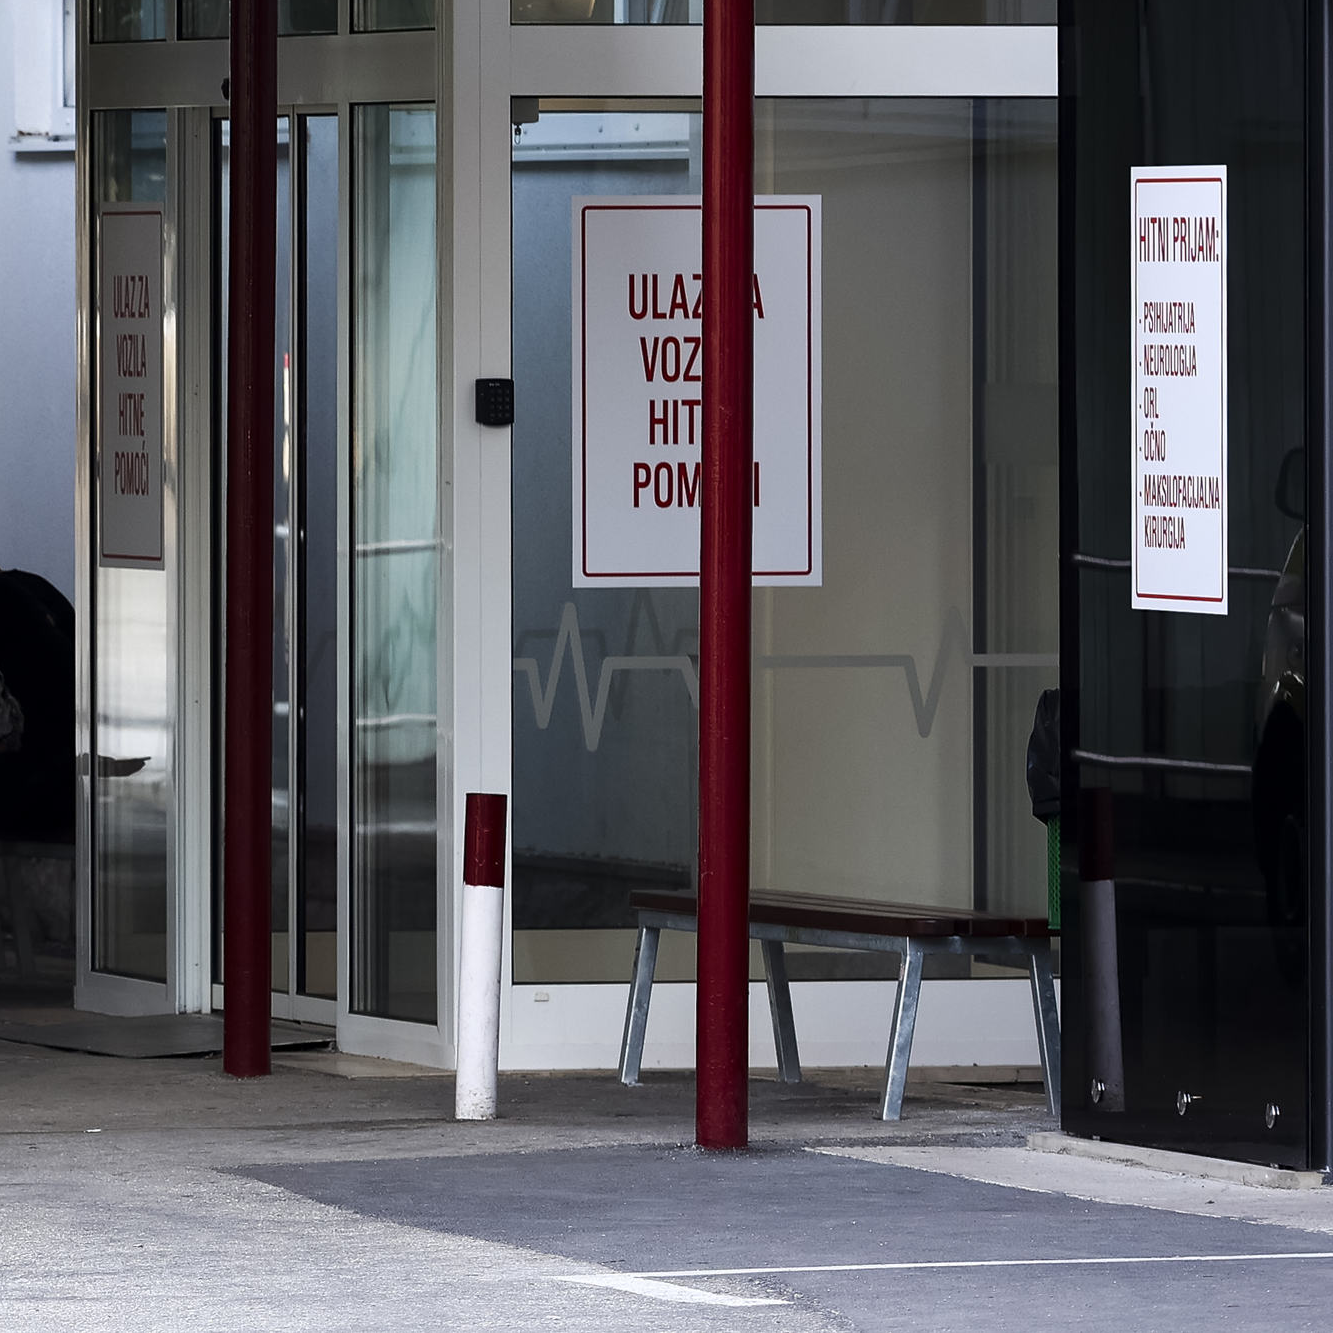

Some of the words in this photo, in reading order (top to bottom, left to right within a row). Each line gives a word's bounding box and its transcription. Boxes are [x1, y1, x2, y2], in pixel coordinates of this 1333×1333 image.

[1139, 217, 1168, 262] HITNI
[1173, 217, 1219, 262] PRIJAM:
[113, 275, 136, 319] ULAZ
[138, 275, 150, 319] ZA
[1144, 301, 1196, 334] PSIHIJATRIJA
[116, 334, 147, 378] VOZILA
[639, 335, 702, 383] VOZ
[1144, 344, 1197, 377] NEUROLOGIJA
[118, 393, 145, 437] HITNE
[649, 399, 702, 445] HIT
[1144, 387, 1159, 419] ORL
[1144, 422, 1166, 462] OČNO
[115, 440, 149, 496] POMOĆI
[633, 462, 761, 509] POMI
[1144, 474, 1220, 510] MAKSILOFACIJALNA
[1144, 516, 1186, 550] KIRURGIJA
